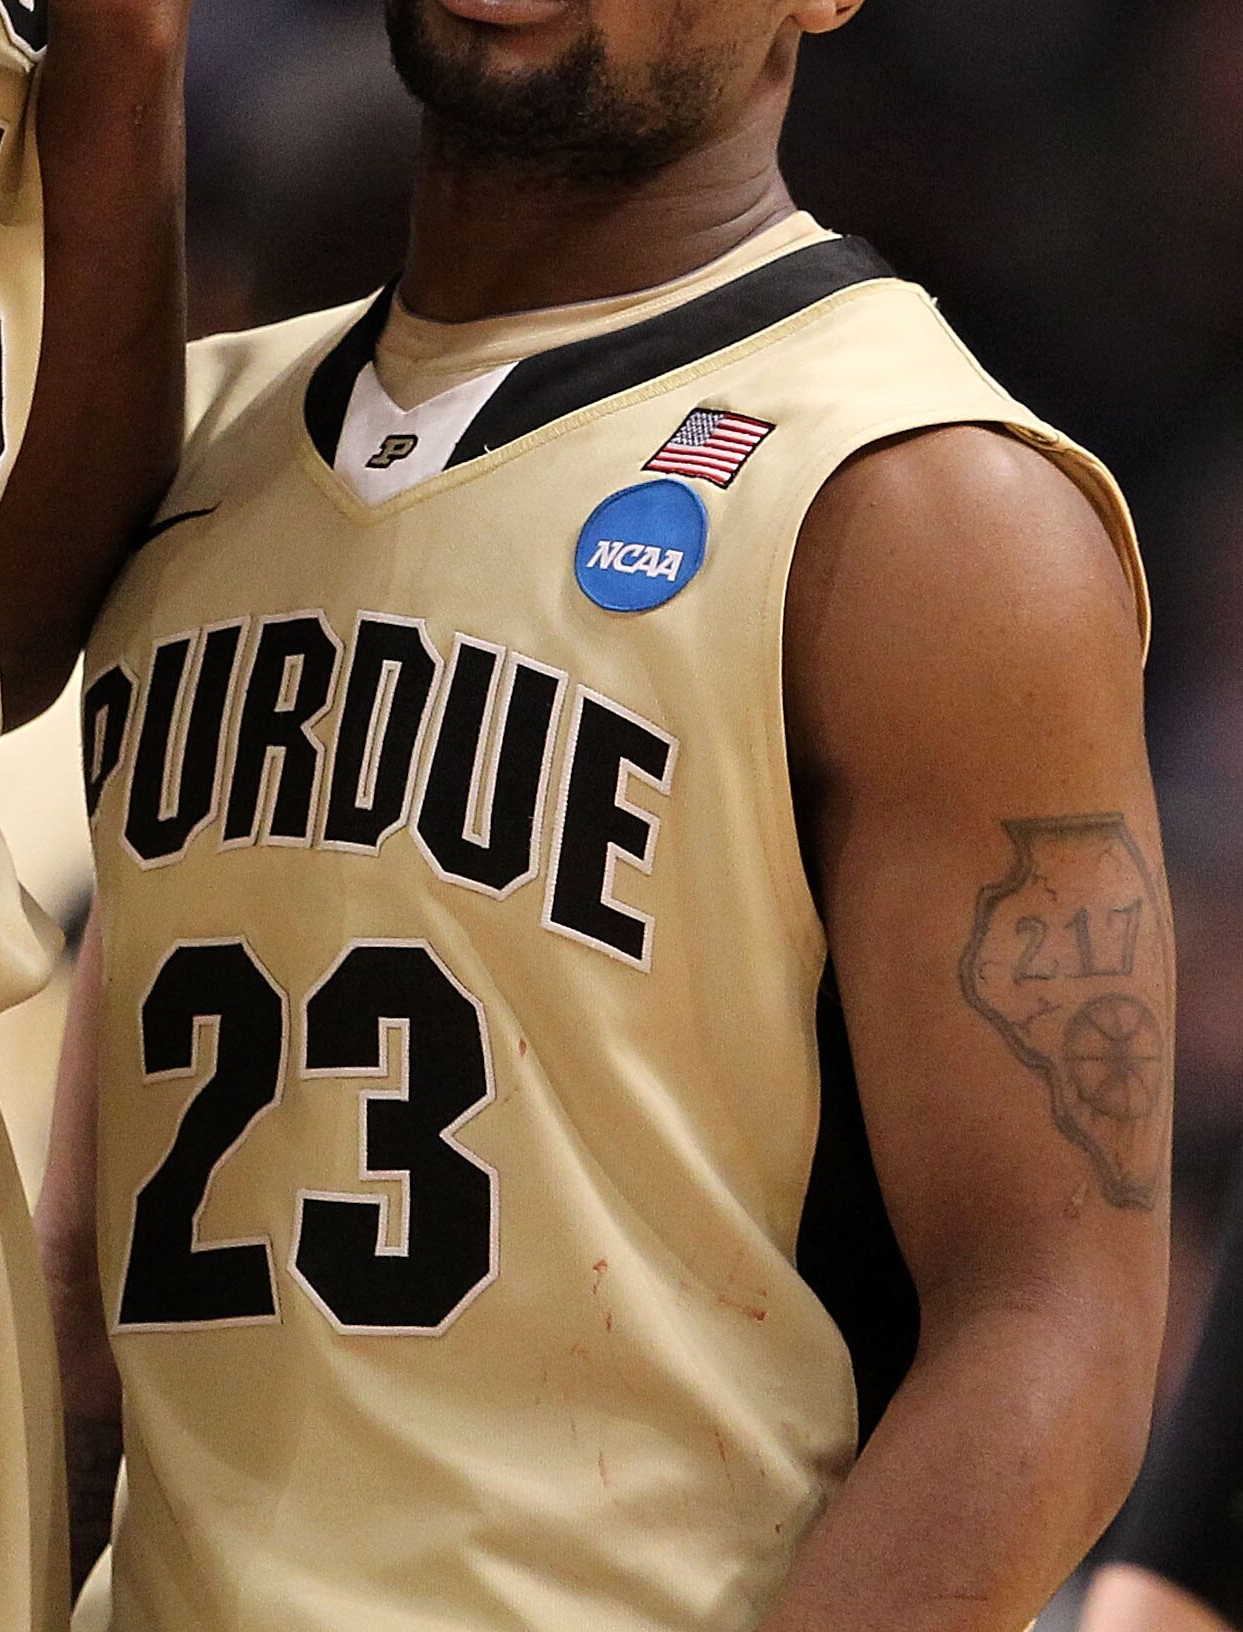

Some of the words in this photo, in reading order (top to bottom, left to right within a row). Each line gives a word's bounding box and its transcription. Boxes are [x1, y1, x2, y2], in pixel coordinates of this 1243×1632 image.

[365, 434, 418, 469] P
[587, 539, 684, 581] NCAA
[83, 608, 680, 973] PURDUE
[1013, 896, 1144, 988] 217
[111, 935, 500, 1337] 23
